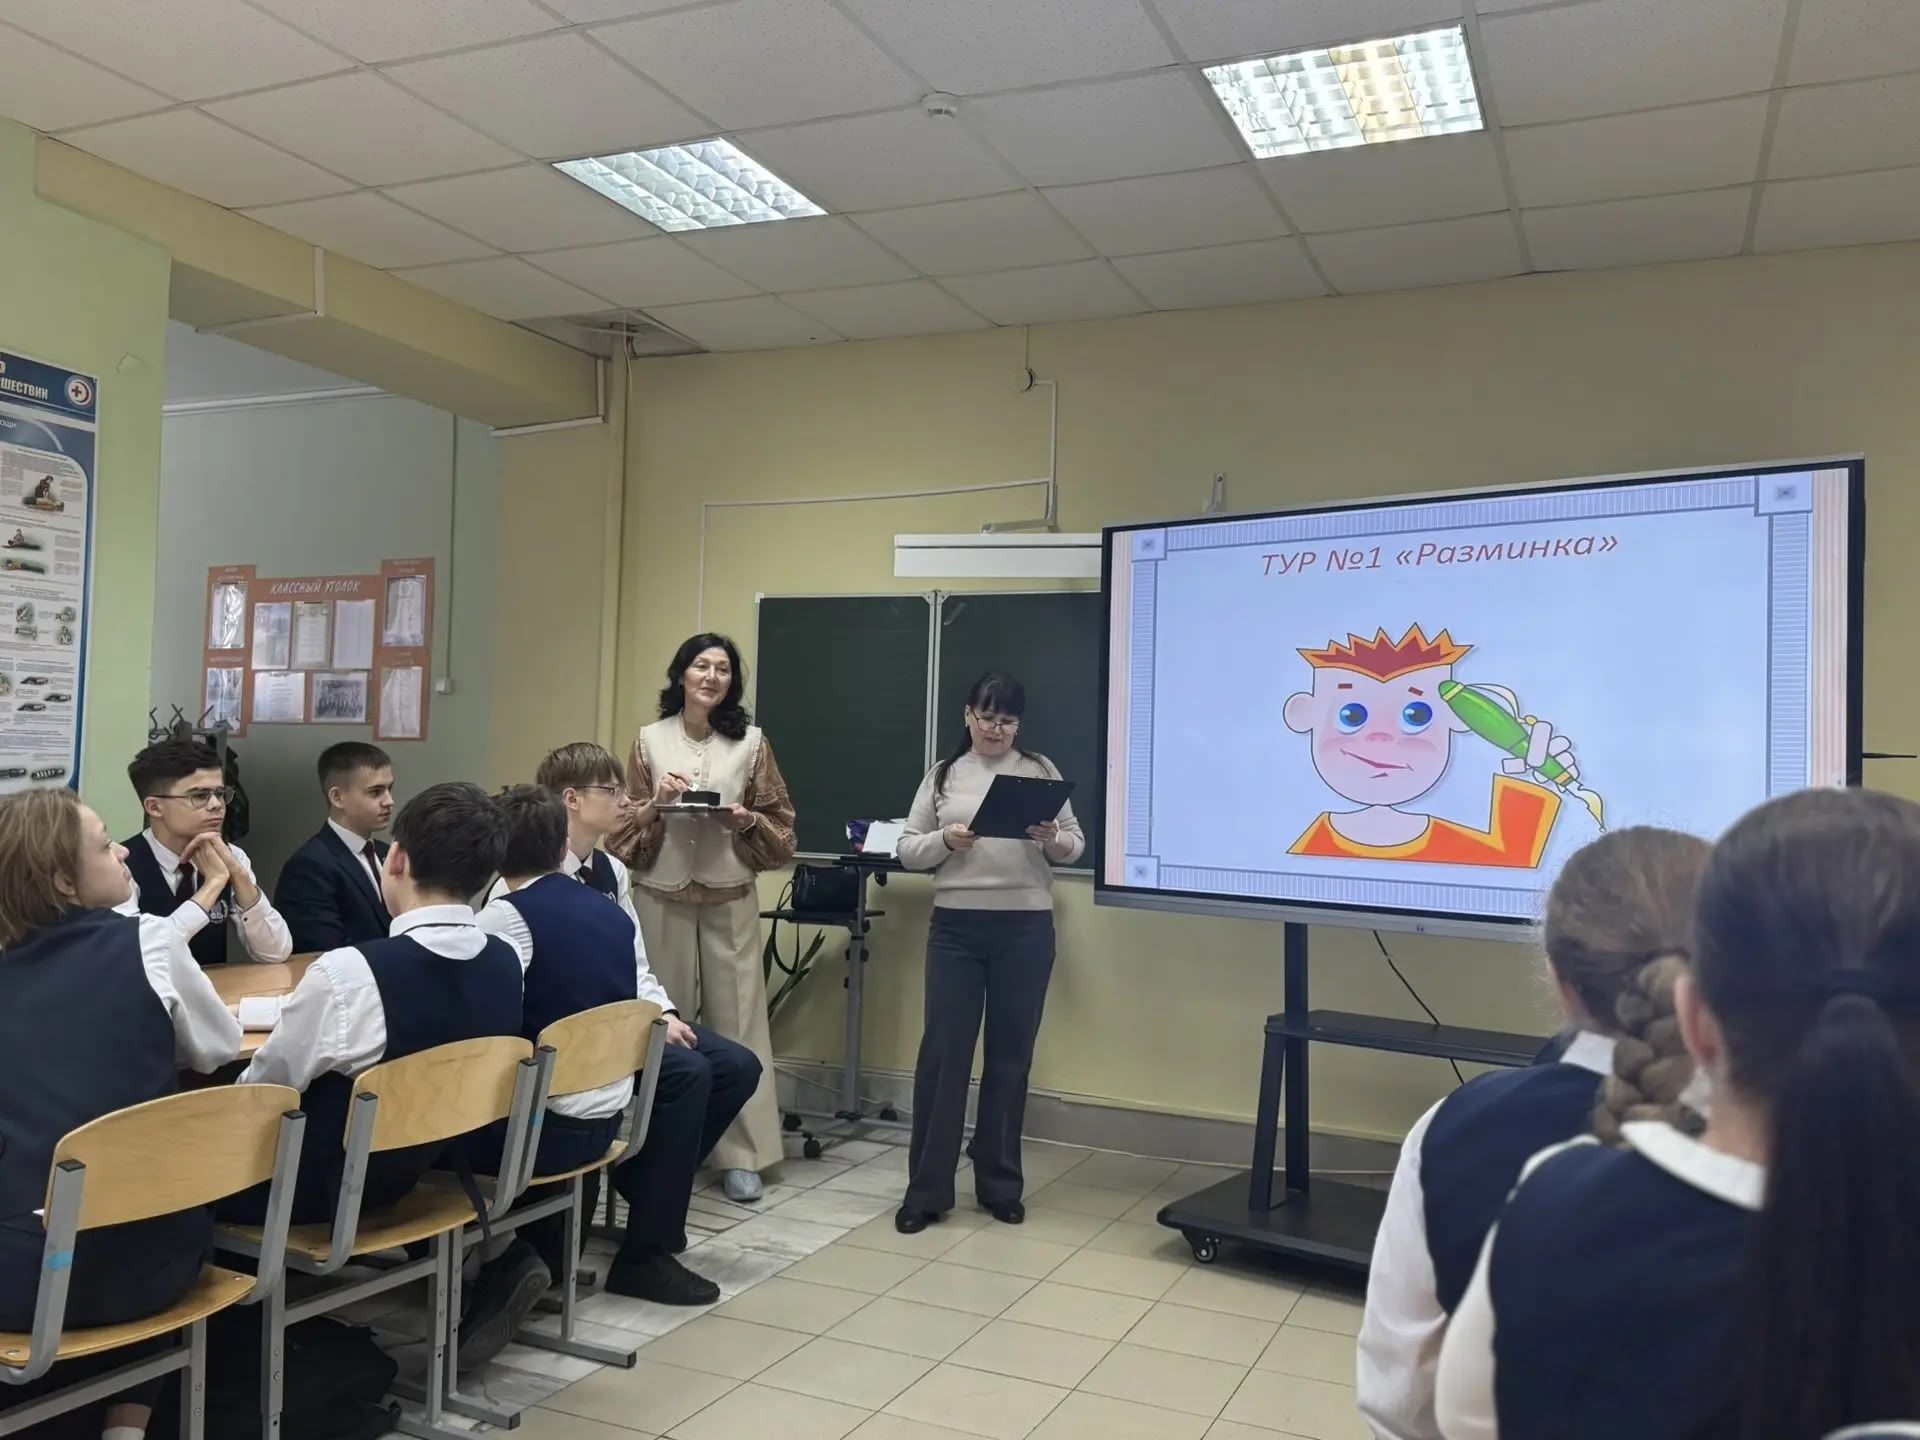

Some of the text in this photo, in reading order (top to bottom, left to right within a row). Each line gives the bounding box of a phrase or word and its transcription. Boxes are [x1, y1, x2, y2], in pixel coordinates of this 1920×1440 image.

[0, 377, 48, 400] ШЕСТВИИ
[1262, 535, 1618, 576] ТУР №1 «Разминка»
[270, 578, 360, 595] КЛАССНЫЙ УГОЛОК
